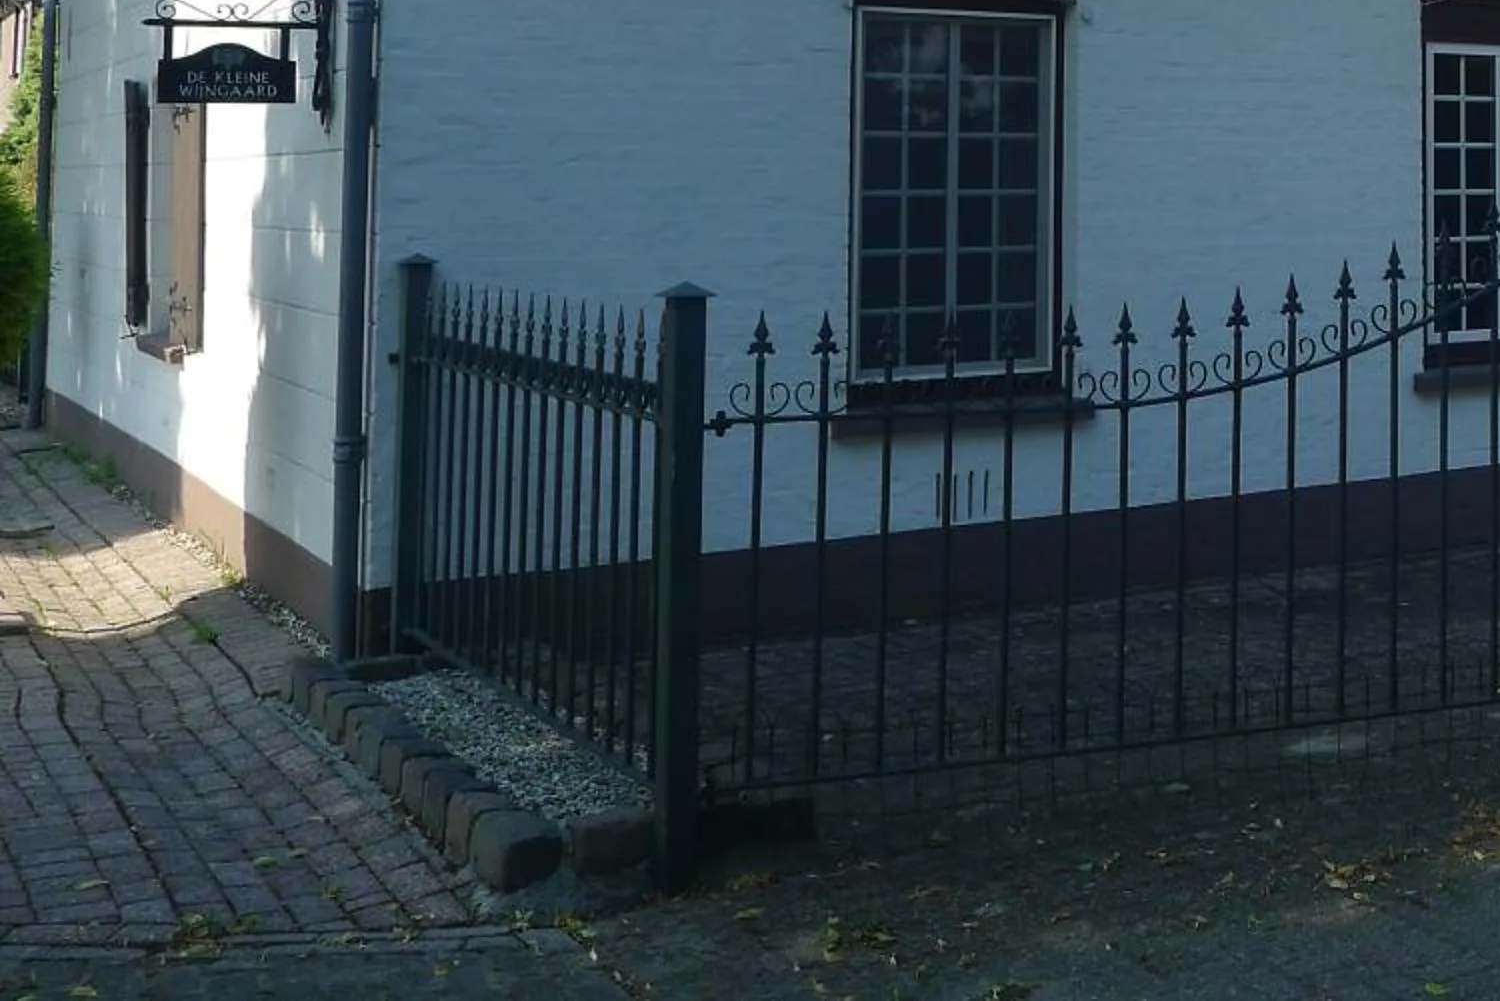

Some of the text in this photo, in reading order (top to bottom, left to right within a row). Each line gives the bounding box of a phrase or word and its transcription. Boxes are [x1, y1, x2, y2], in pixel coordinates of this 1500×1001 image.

[187, 70, 270, 84] DE KLEINE
[178, 84, 278, 97] WIJNGAARD
